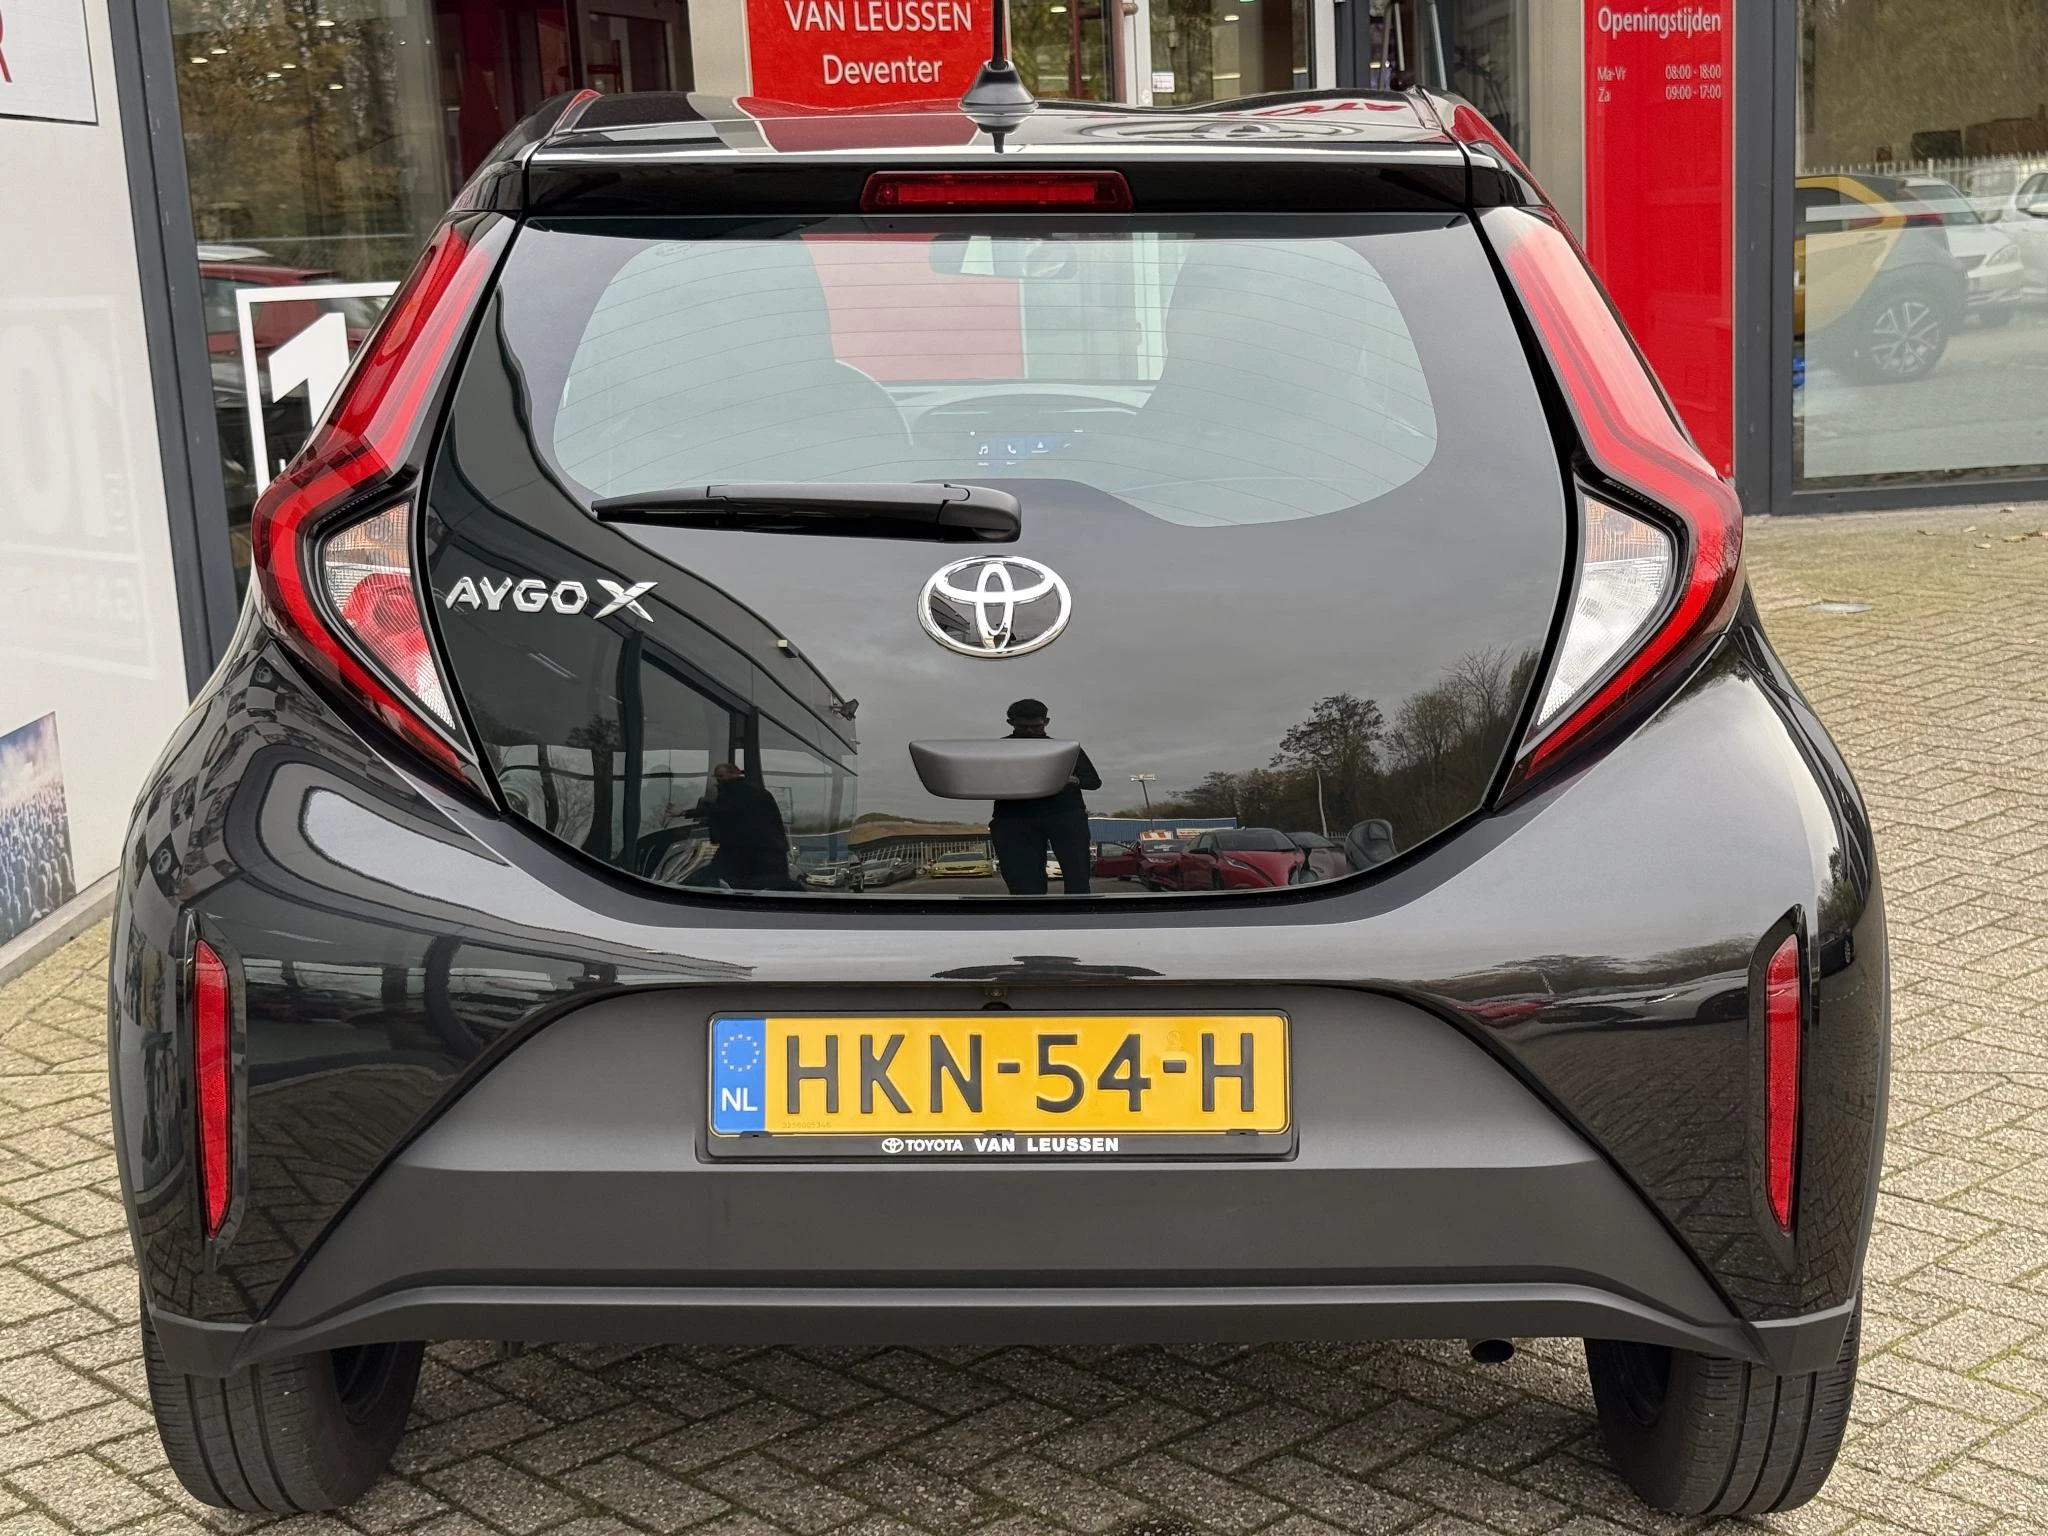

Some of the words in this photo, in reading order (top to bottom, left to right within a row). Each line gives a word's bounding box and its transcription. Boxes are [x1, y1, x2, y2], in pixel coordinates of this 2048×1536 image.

[784, 1, 846, 32] VAN
[854, 1, 973, 32] LEUSSEN
[1597, 5, 1721, 39] Openingstijden
[821, 54, 943, 85] Deventer
[1665, 64, 1691, 80] 08:00
[1699, 64, 1722, 80] 18:00
[1598, 88, 1611, 102] Za
[1665, 85, 1691, 100] 09:00
[1699, 84, 1722, 100] 17:00
[445, 575, 588, 615] AYGO
[592, 578, 659, 623] X
[786, 1033, 1255, 1115] HKN-54-H
[721, 1087, 758, 1112] NL
[905, 1139, 964, 1152] TOYOTA
[974, 1137, 1015, 1152] VAN
[1027, 1137, 1119, 1152] LEUSSEN
